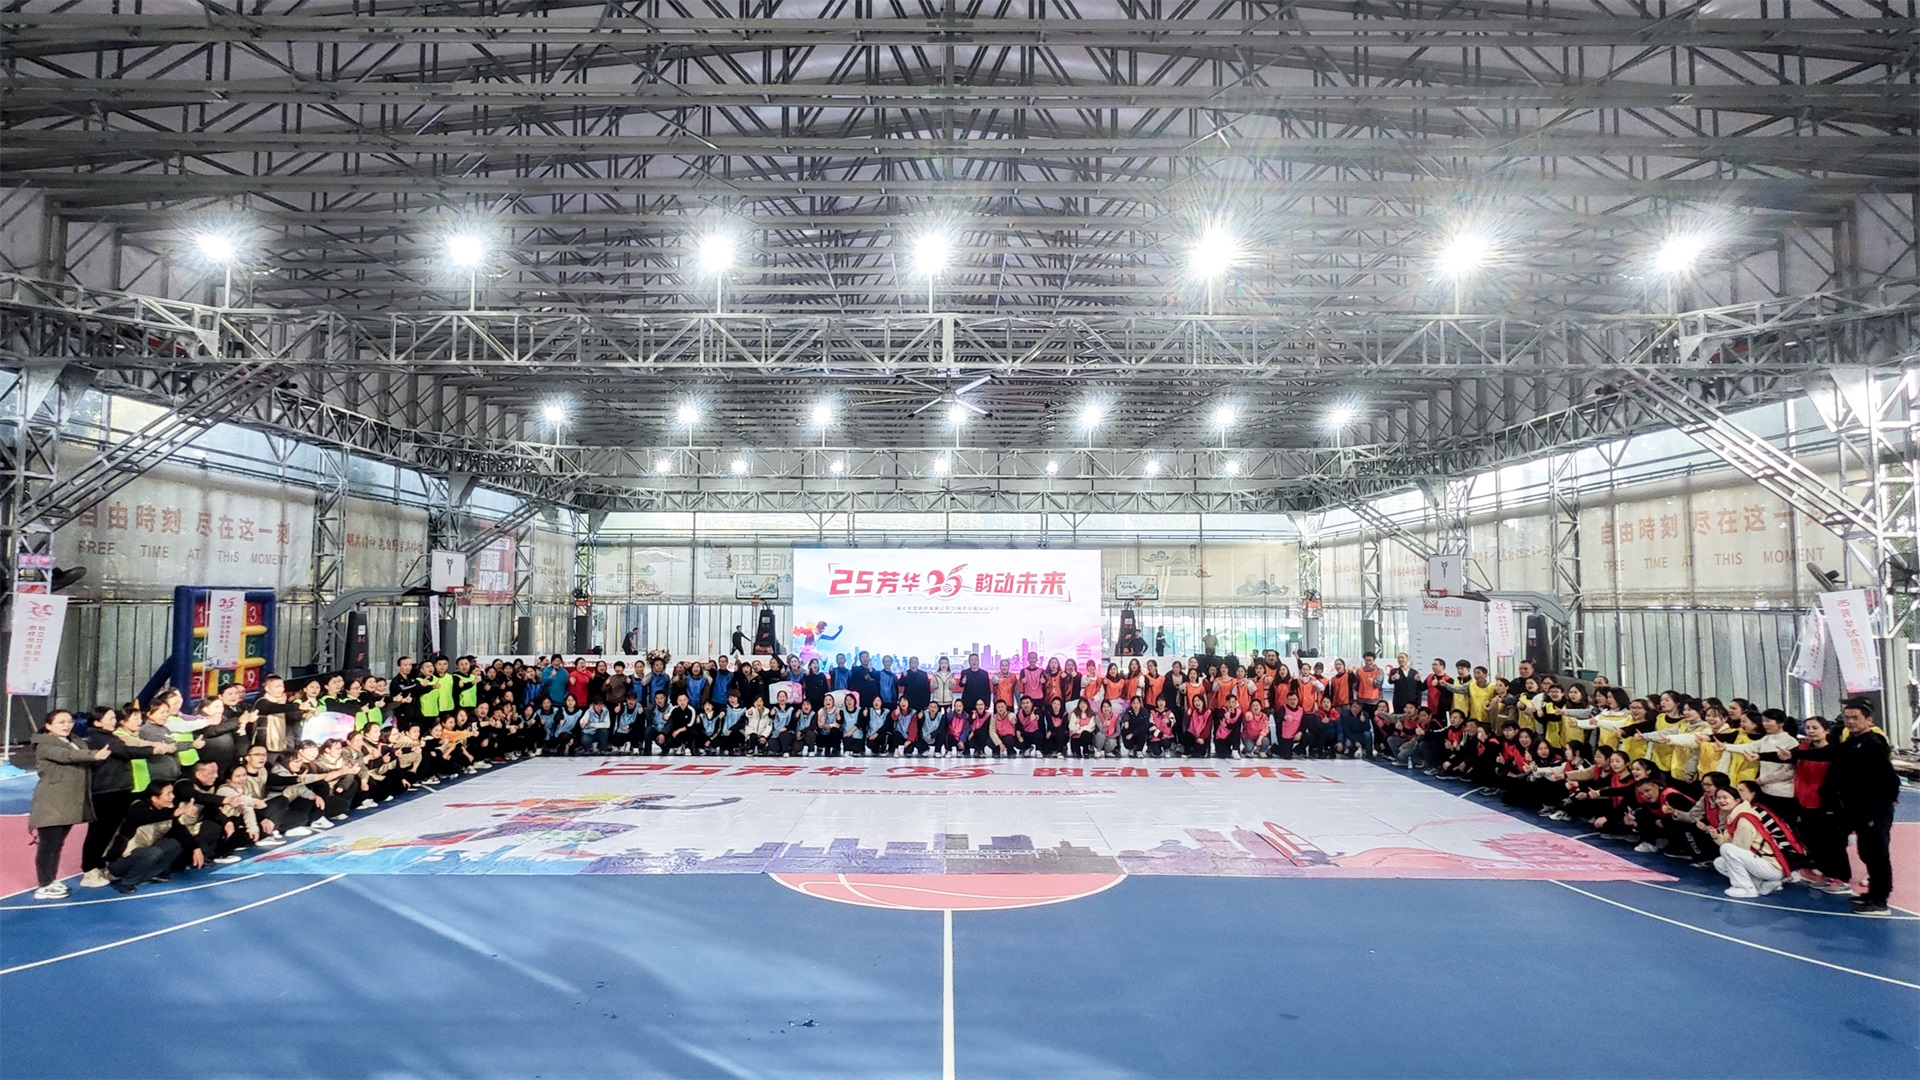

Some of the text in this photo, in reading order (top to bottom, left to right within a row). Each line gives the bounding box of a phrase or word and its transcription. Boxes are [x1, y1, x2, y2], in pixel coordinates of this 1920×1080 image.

[78, 498, 290, 545] 自由時刻 尽在这一刻
[1601, 513, 1678, 546] 自由時刻
[78, 540, 115, 555] FREE
[140, 545, 169, 558] TIME
[187, 548, 201, 560] AT
[251, 553, 288, 566] MOMENT
[1644, 557, 1667, 569] TIME
[1682, 554, 1694, 567] AT
[1715, 553, 1742, 566] THIS
[829, 569, 921, 595] 25芳华
[975, 571, 1066, 595] 韵动未来
[249, 606, 257, 622] 3
[193, 640, 204, 658] 4
[248, 671, 256, 687] 9
[577, 763, 868, 777] 25芳华
[1033, 766, 1307, 780] 韵动未来
